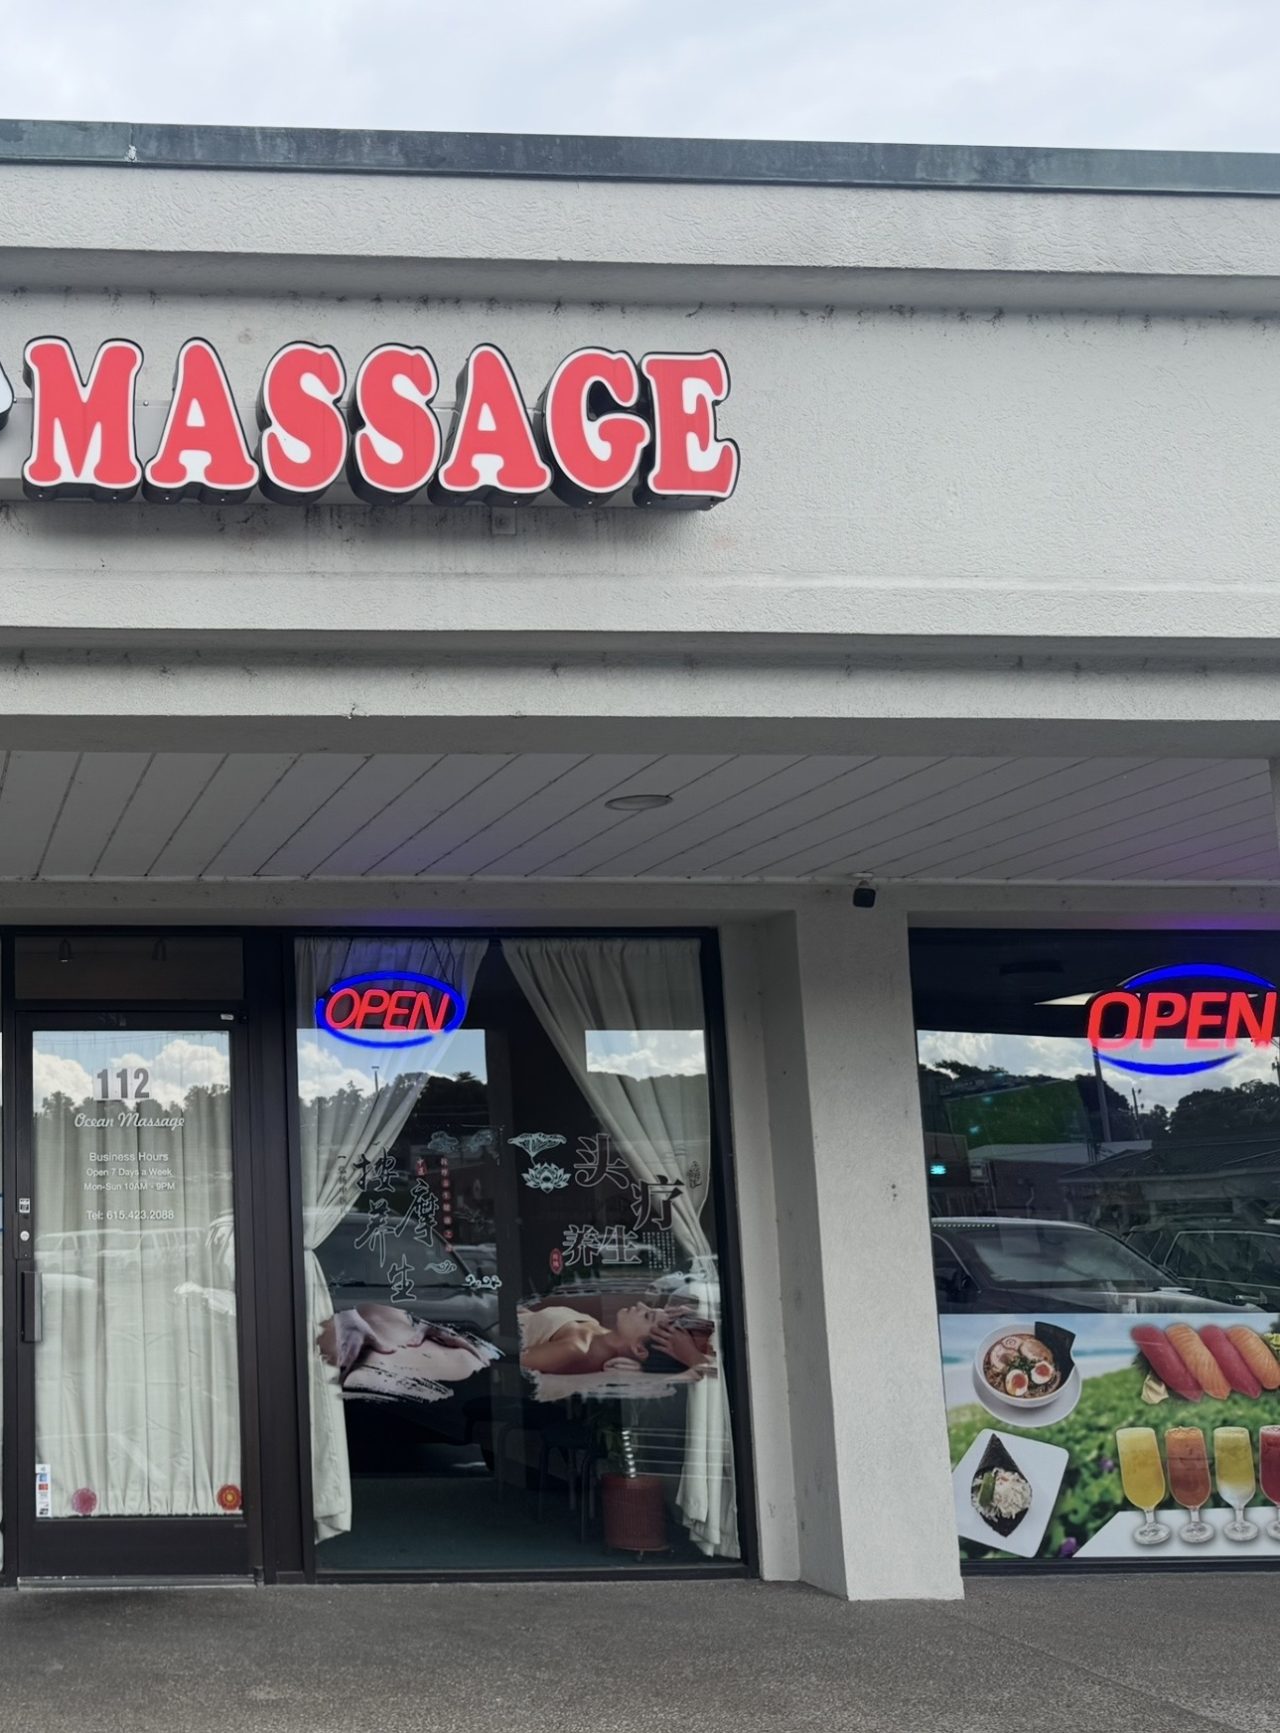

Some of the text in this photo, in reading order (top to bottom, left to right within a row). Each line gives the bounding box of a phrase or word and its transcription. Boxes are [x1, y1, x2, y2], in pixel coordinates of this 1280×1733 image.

[23, 336, 739, 500] MASSAGE
[325, 988, 450, 1033] OPEN
[1087, 991, 1278, 1050] OPEN
[97, 1068, 150, 1099] 112
[74, 1112, 185, 1131] Ocean Massage
[89, 1152, 169, 1162] Business Hours
[86, 1168, 109, 1178] Open
[111, 1168, 116, 1176] 7
[119, 1168, 139, 1178] Days
[149, 1168, 173, 1176] Week
[84, 1182, 122, 1191] Mon-Sun
[125, 1182, 148, 1191] 10AM
[156, 1182, 176, 1191] 9PM
[86, 1210, 175, 1220] Tel: 615.423.2088
